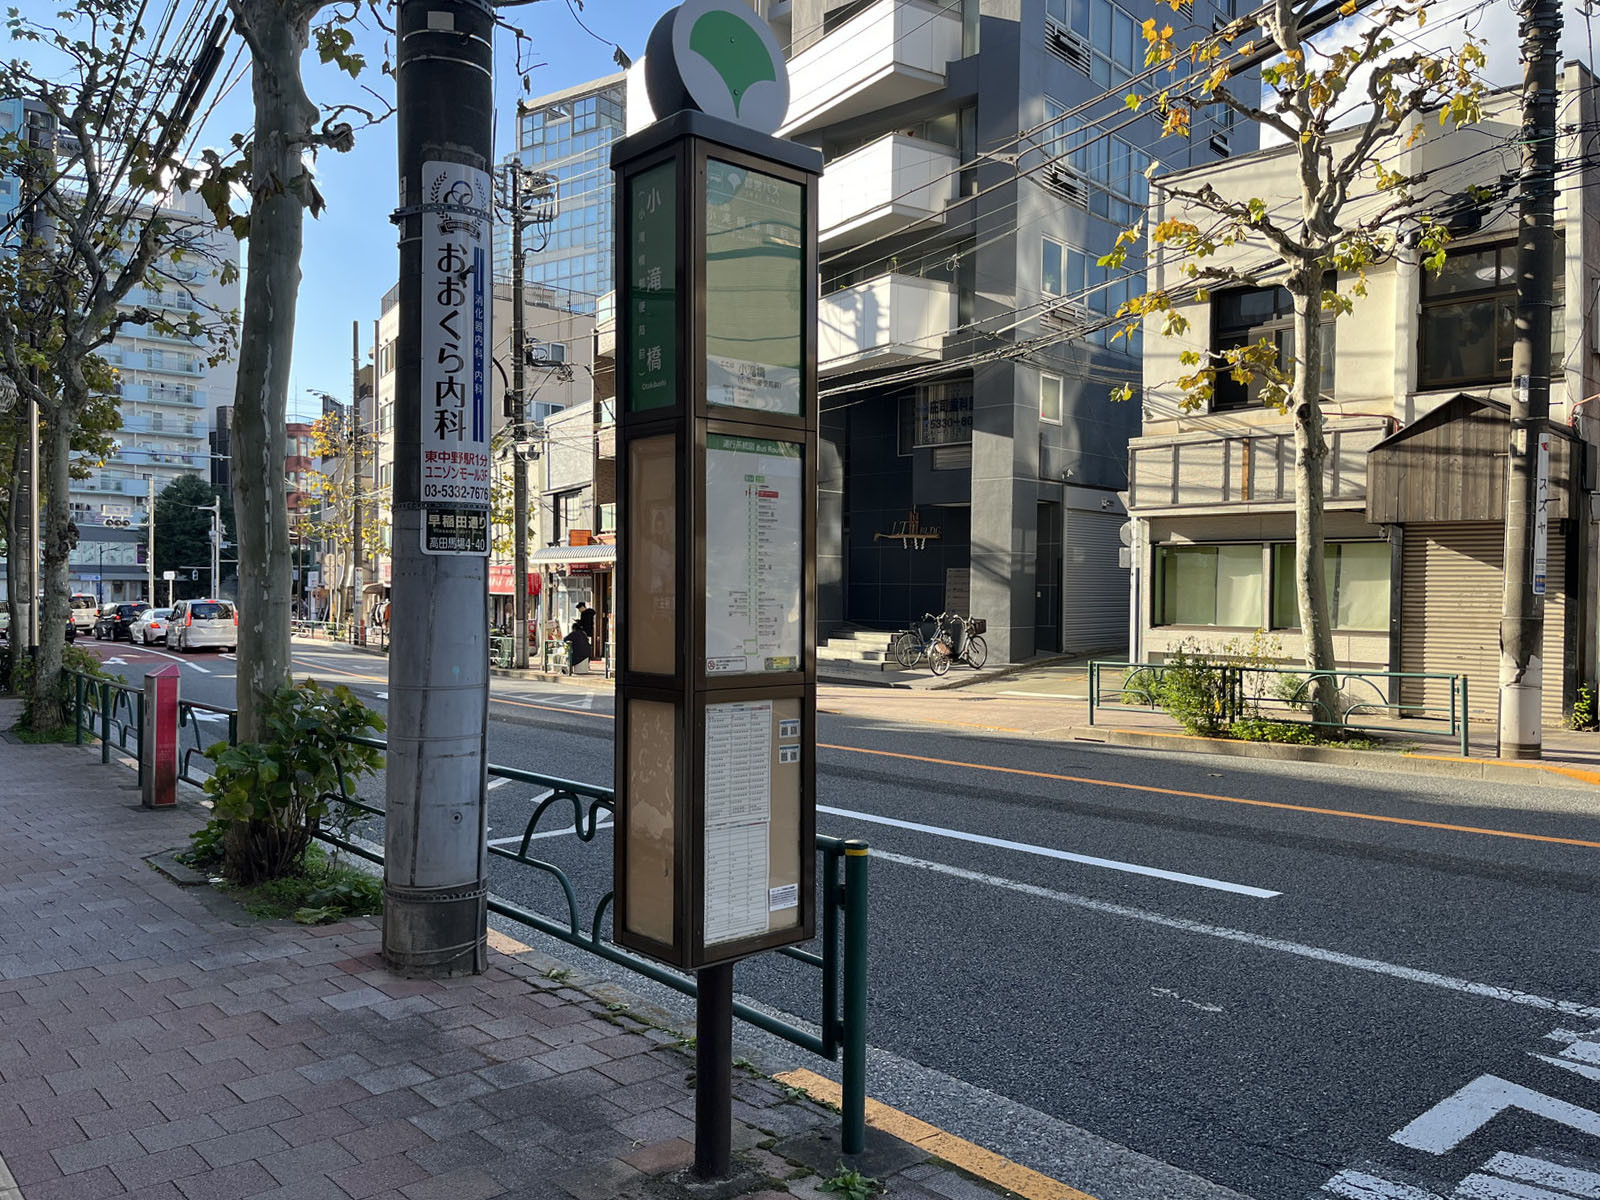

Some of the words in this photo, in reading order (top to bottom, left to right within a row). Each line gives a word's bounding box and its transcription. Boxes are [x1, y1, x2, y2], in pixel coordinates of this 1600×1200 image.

[646, 186, 662, 372] 小滝橋
[434, 243, 468, 442] おおくら内科
[424, 450, 488, 467] 東中野駅1分
[424, 465, 488, 482] ユニソンモール3F
[424, 484, 489, 501] 03-5332-7676
[428, 514, 486, 529] 早稲田通り
[429, 536, 485, 551] 高田馬場4-40
